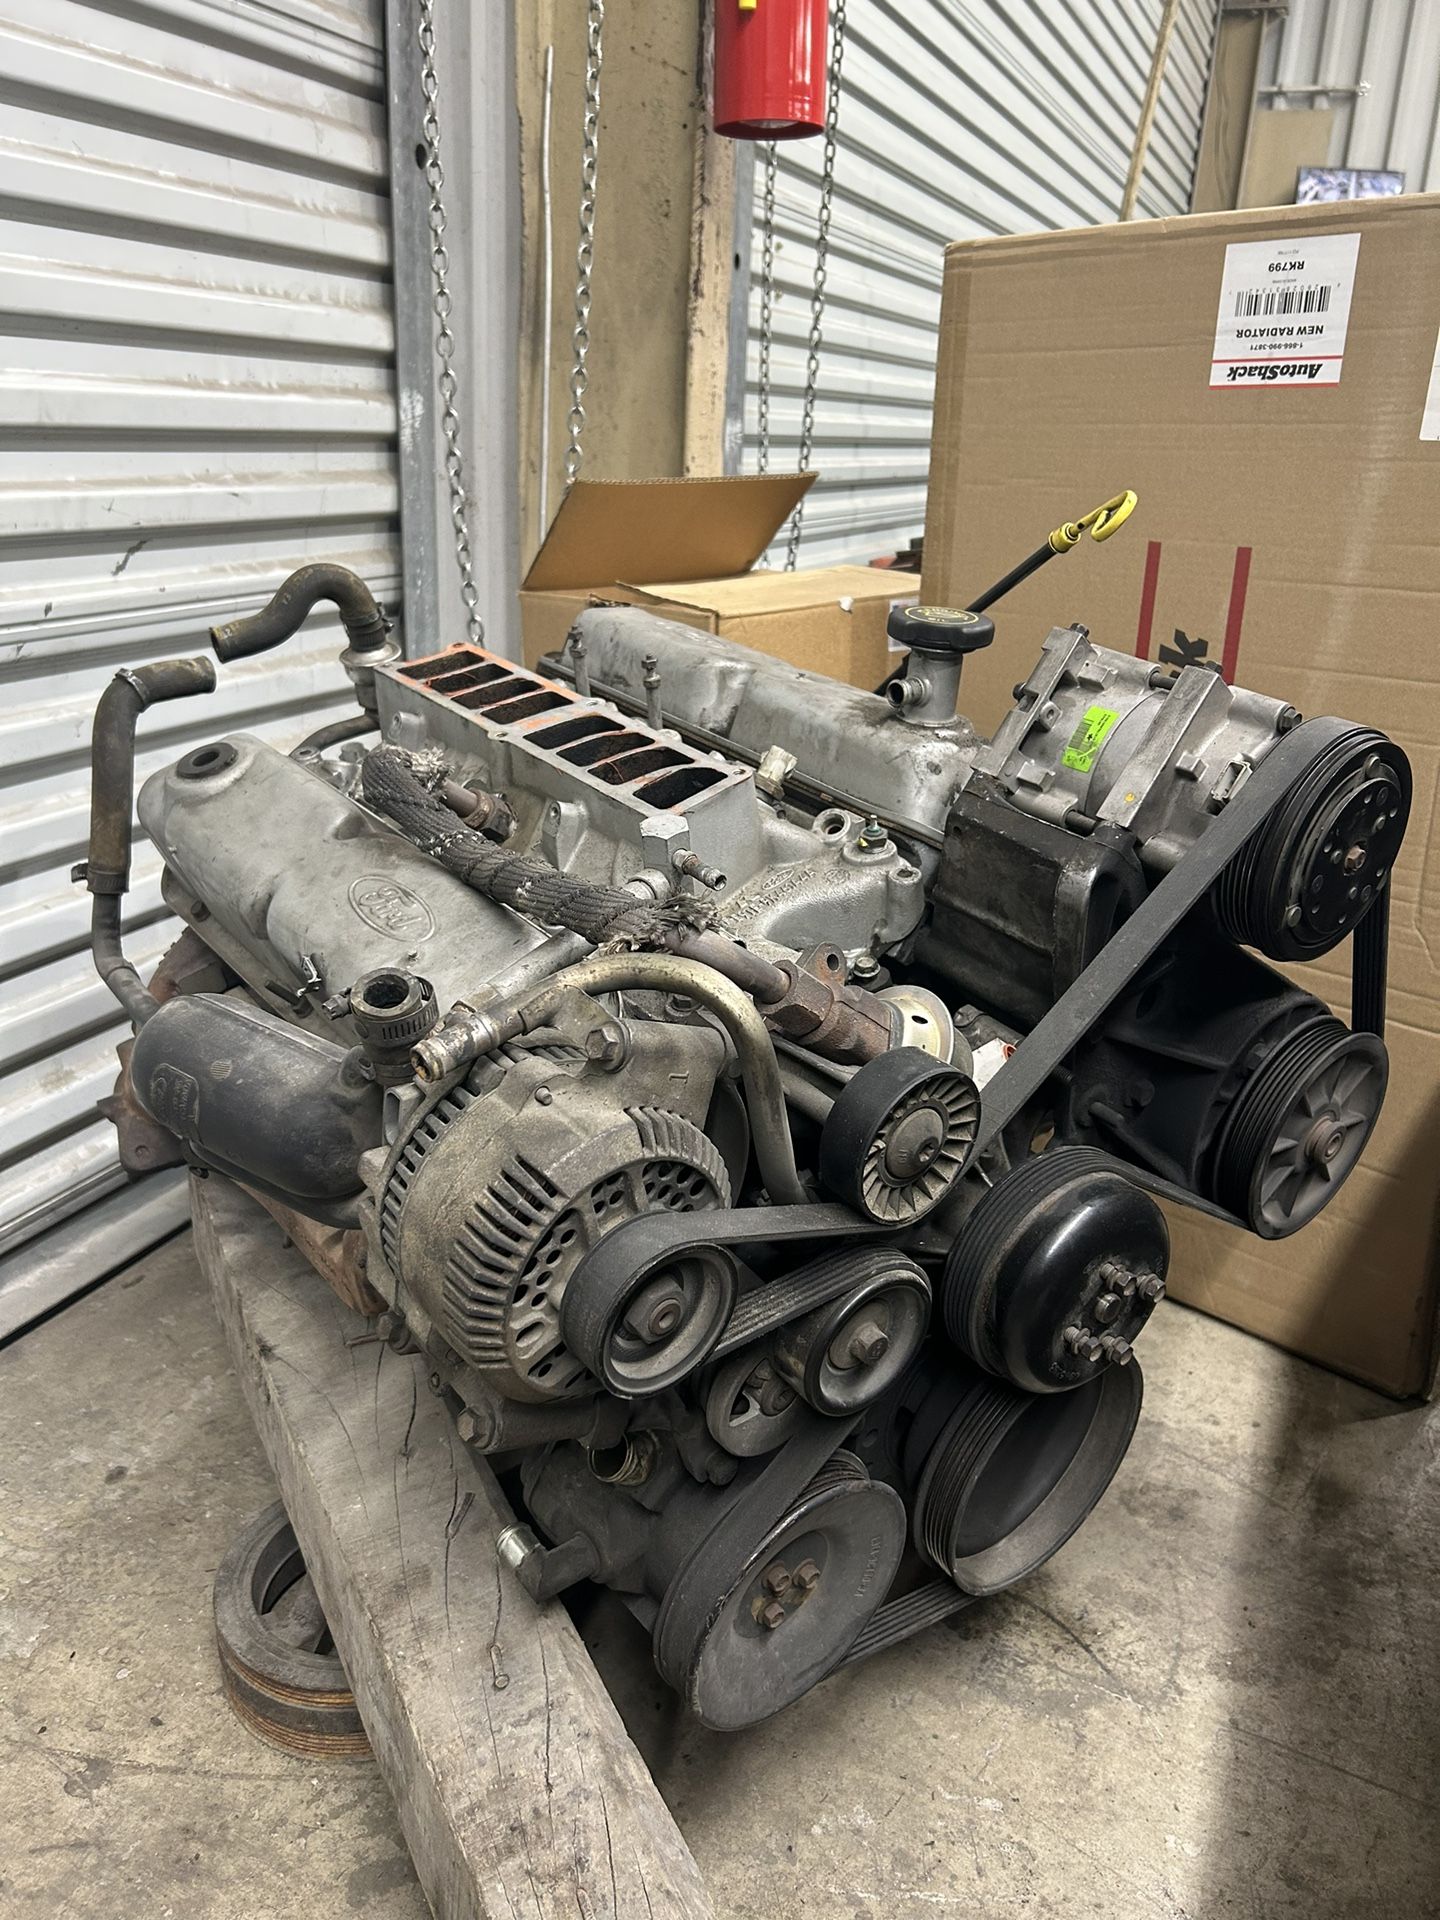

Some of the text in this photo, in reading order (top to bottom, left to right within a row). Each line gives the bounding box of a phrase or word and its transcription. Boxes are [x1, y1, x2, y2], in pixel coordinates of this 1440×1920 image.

[1268, 260, 1305, 272] RK799
[1236, 325, 1324, 338] NEW RADIATOR
[1249, 342, 1303, 351] 1-866-990-3871
[1227, 363, 1323, 381] AutoShack
[356, 884, 425, 933] Ford
